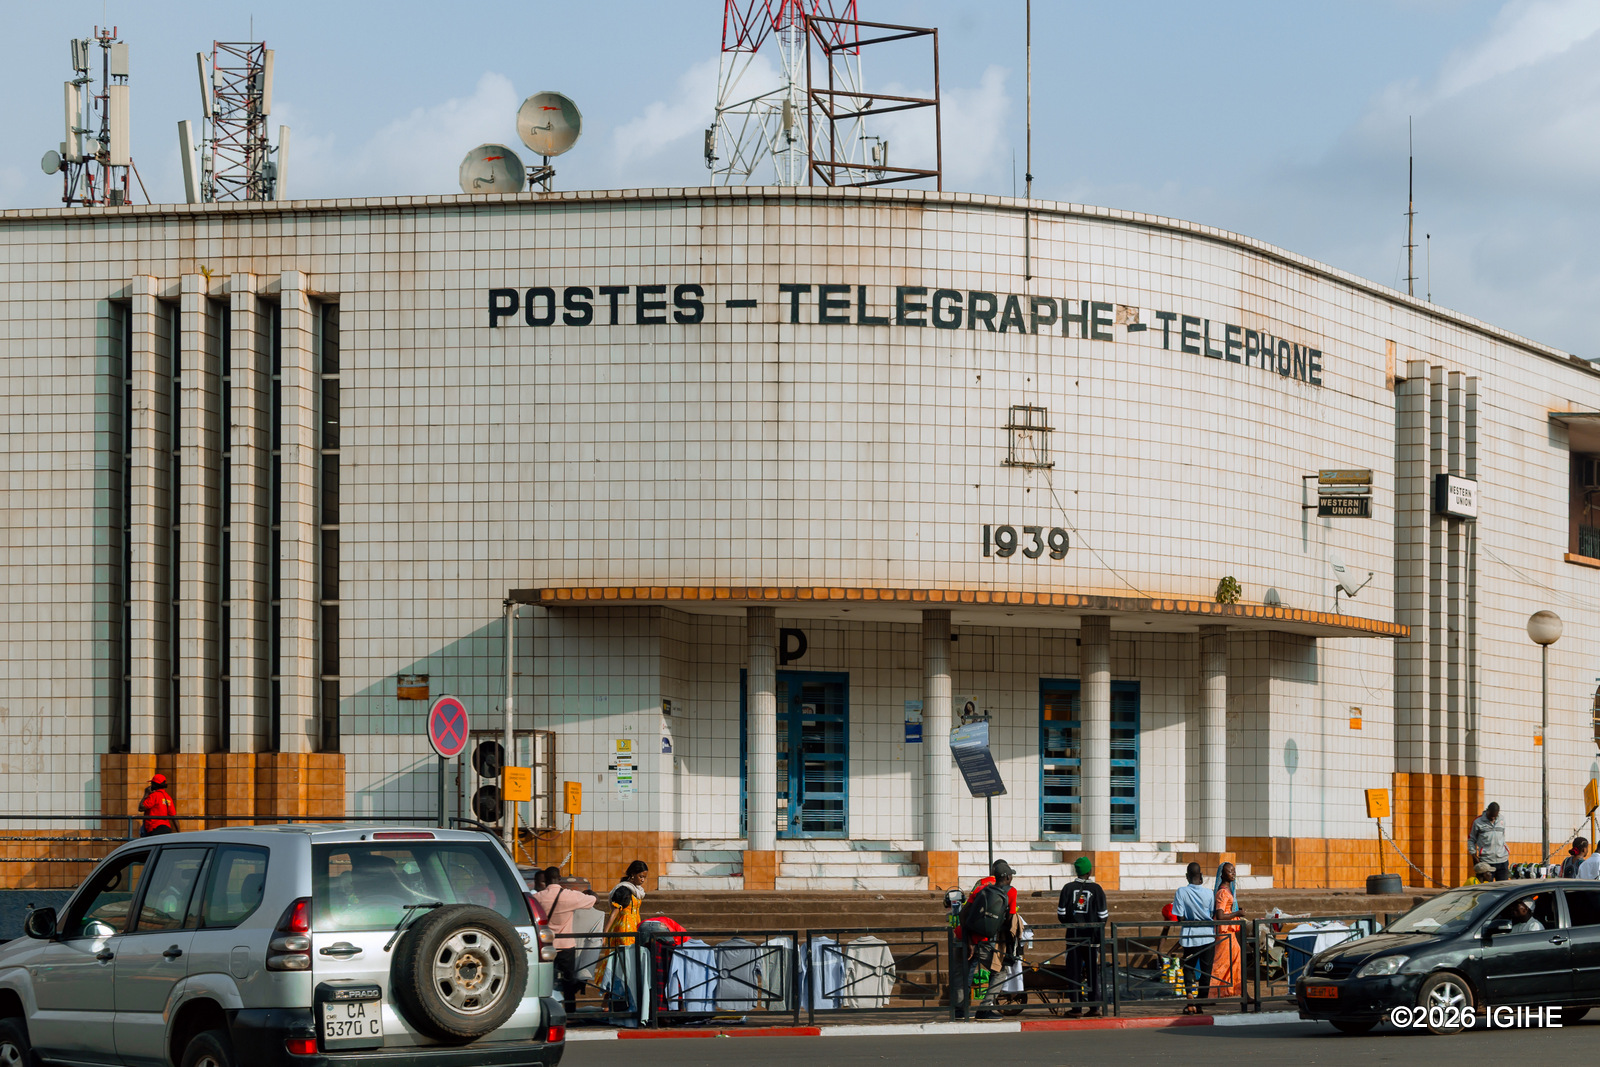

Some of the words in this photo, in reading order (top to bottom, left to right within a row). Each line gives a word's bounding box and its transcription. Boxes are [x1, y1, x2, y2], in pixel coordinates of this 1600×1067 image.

[488, 284, 705, 328] POSTES
[779, 284, 1114, 342] TELEGRAPHE
[1155, 310, 1322, 386] TELEPHONE
[1449, 485, 1472, 498] WESTERN
[1320, 499, 1359, 507] WESTERN
[1456, 496, 1472, 507] UNION
[983, 525, 1070, 561] 1939
[780, 628, 808, 666] P
[349, 989, 379, 998] PRADO
[347, 1003, 365, 1018] CA
[326, 1021, 362, 1037] 5370
[370, 1020, 379, 1034] C
